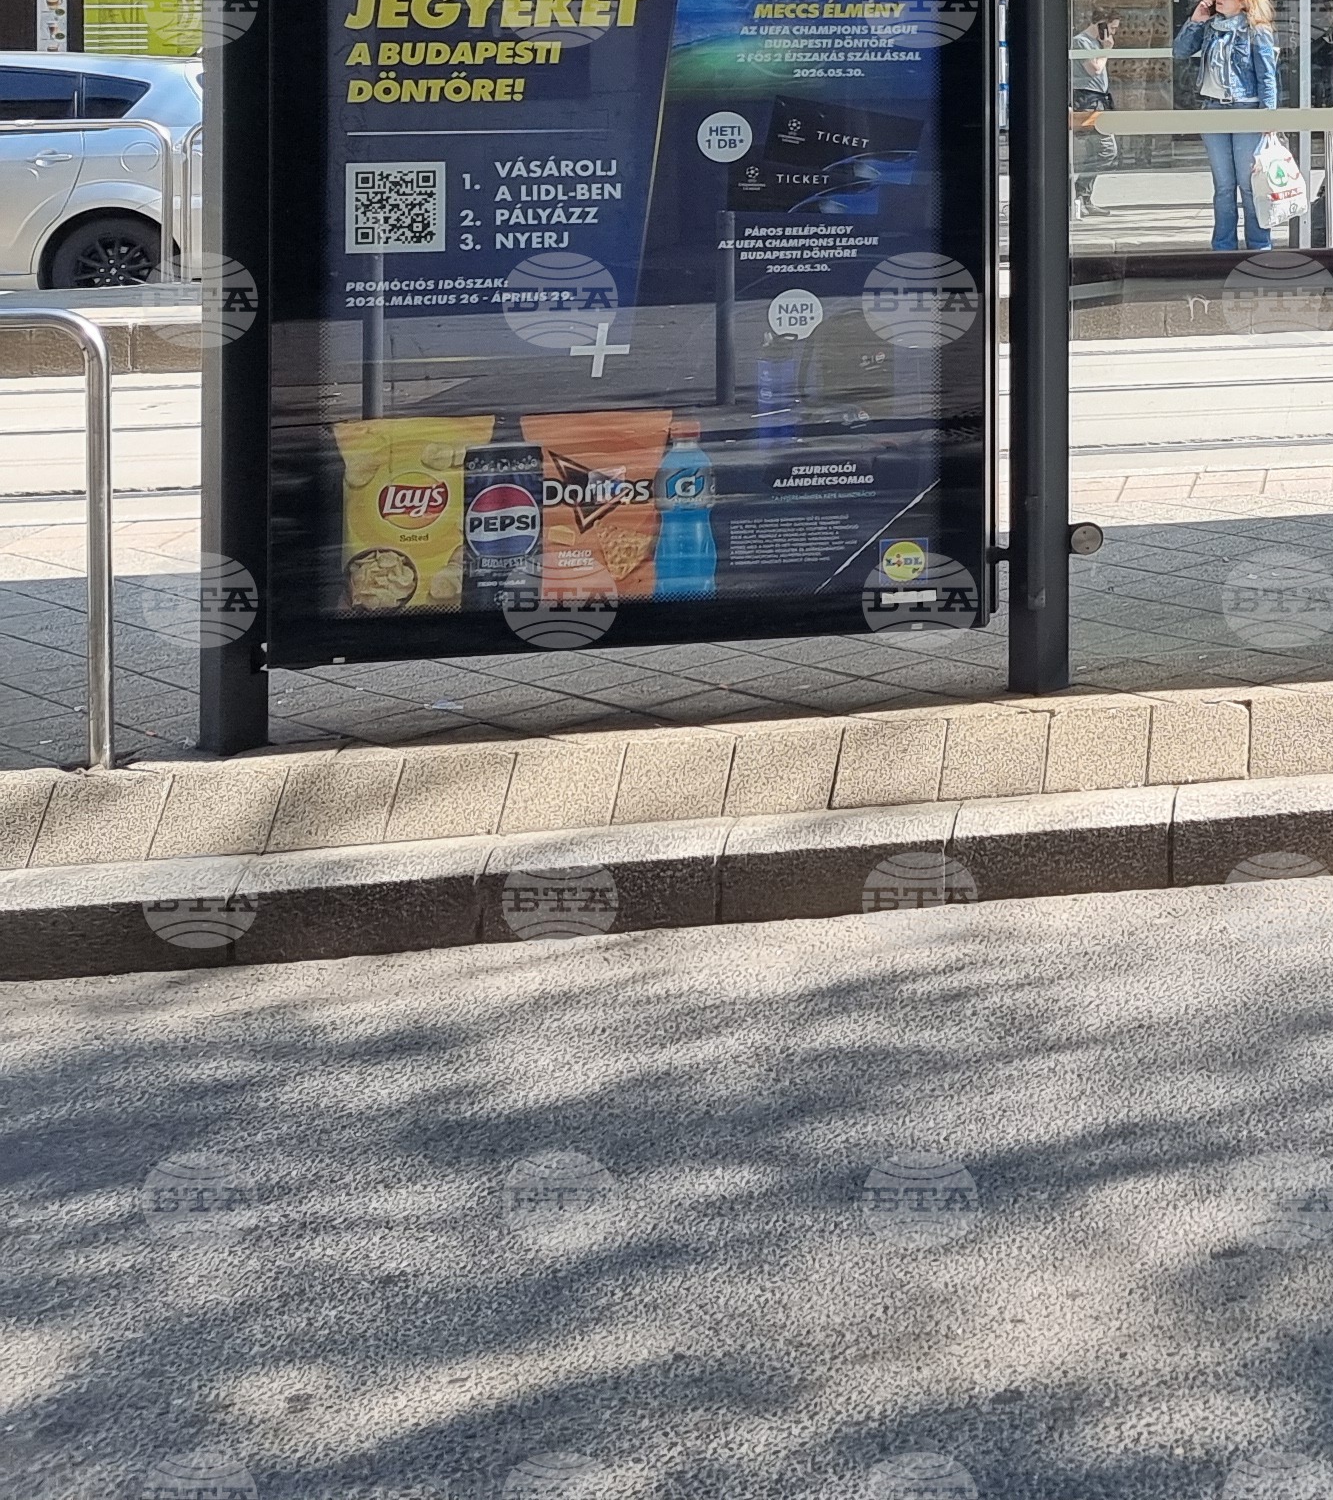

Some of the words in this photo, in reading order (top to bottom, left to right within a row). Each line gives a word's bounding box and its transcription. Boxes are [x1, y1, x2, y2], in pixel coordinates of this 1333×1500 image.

[754, 4, 819, 19] MECCS
[823, 0, 906, 19] ÉLMÉNY
[759, 25, 790, 35] UEFA
[792, 25, 869, 35] CHAMPIONS
[870, 25, 918, 35] LEAGUE
[764, 39, 832, 49] BUDAPESTI
[345, 42, 371, 66] A
[378, 41, 562, 66] BUDAPESTI
[347, 71, 525, 103] DÖNTŐRE!
[709, 126, 741, 137] HETI
[816, 131, 870, 149] TICKET
[462, 173, 481, 190] 1.
[494, 156, 617, 178] VÁSÁROLJ
[777, 174, 829, 185] TICKET
[495, 186, 512, 202] A
[521, 183, 622, 202] LIDL-BEN
[460, 210, 482, 227] 2.
[495, 204, 599, 226] PÁLYÁZZ
[744, 225, 784, 237] PÁROS
[460, 234, 482, 251] 3.
[495, 232, 569, 250] NYERJ
[735, 238, 763, 249] UEFA
[765, 237, 834, 248] CHAMPIONS
[836, 236, 879, 246] LEAGUE
[740, 249, 802, 260] BUDAPESTI
[346, 277, 435, 292] PROMÓCIÓS
[438, 276, 509, 291] IDŐSZAK:
[459, 293, 480, 305] 26
[491, 289, 548, 303] ÁPRILIS
[778, 303, 814, 314] NAPI
[791, 463, 857, 476] SZURKOLÓI
[773, 474, 874, 488] AJÁNDÉKCSOMAG
[543, 478, 650, 508] Doritos
[469, 514, 537, 534] PEPSI
